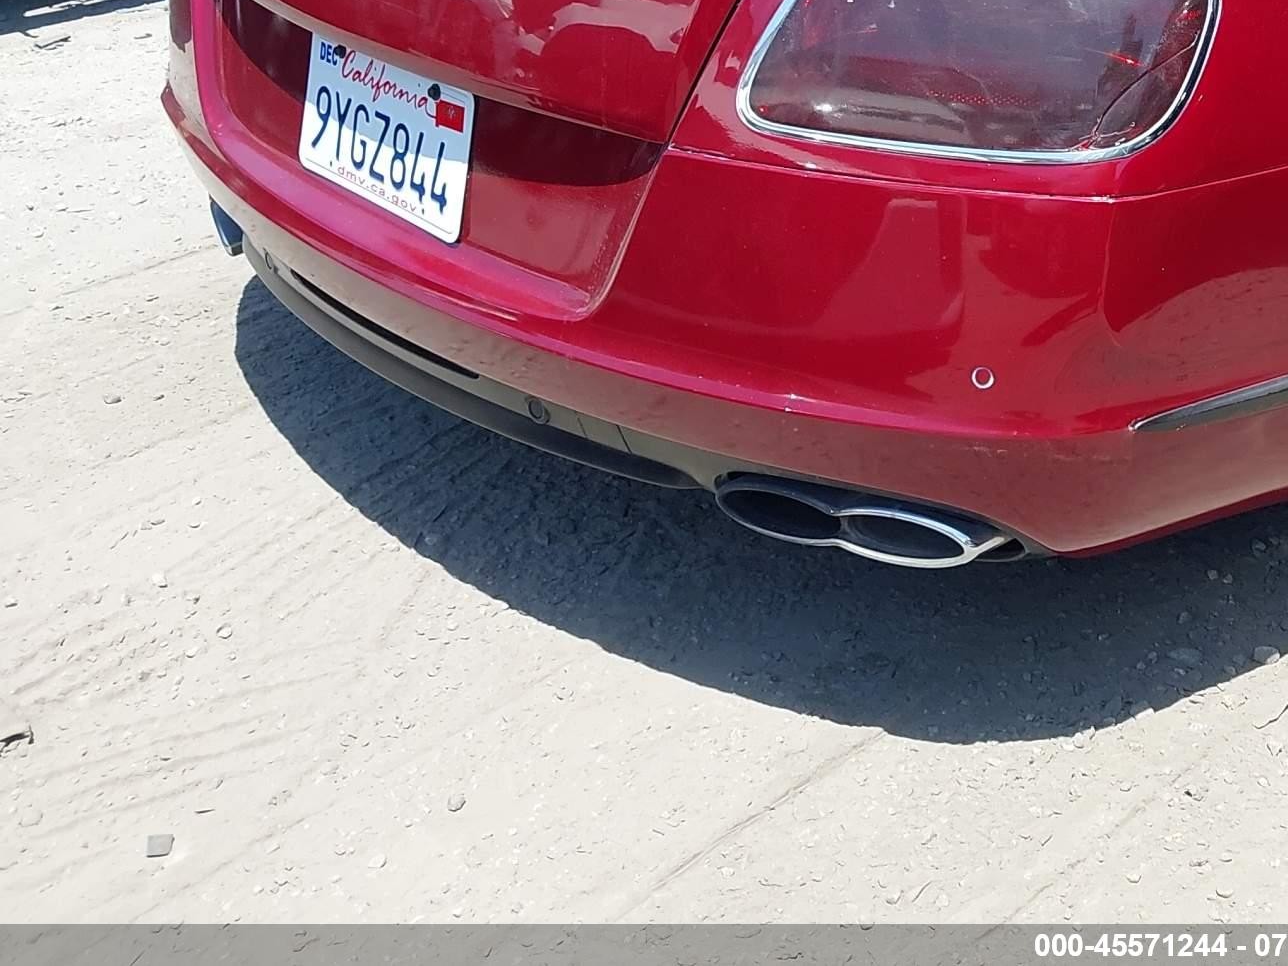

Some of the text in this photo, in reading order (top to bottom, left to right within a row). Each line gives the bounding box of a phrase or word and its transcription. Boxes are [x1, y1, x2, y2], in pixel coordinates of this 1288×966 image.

[319, 41, 338, 67] DEC
[342, 49, 437, 118] California
[311, 85, 447, 215] 9YGZ844
[337, 165, 418, 213] dmv.ca.gov
